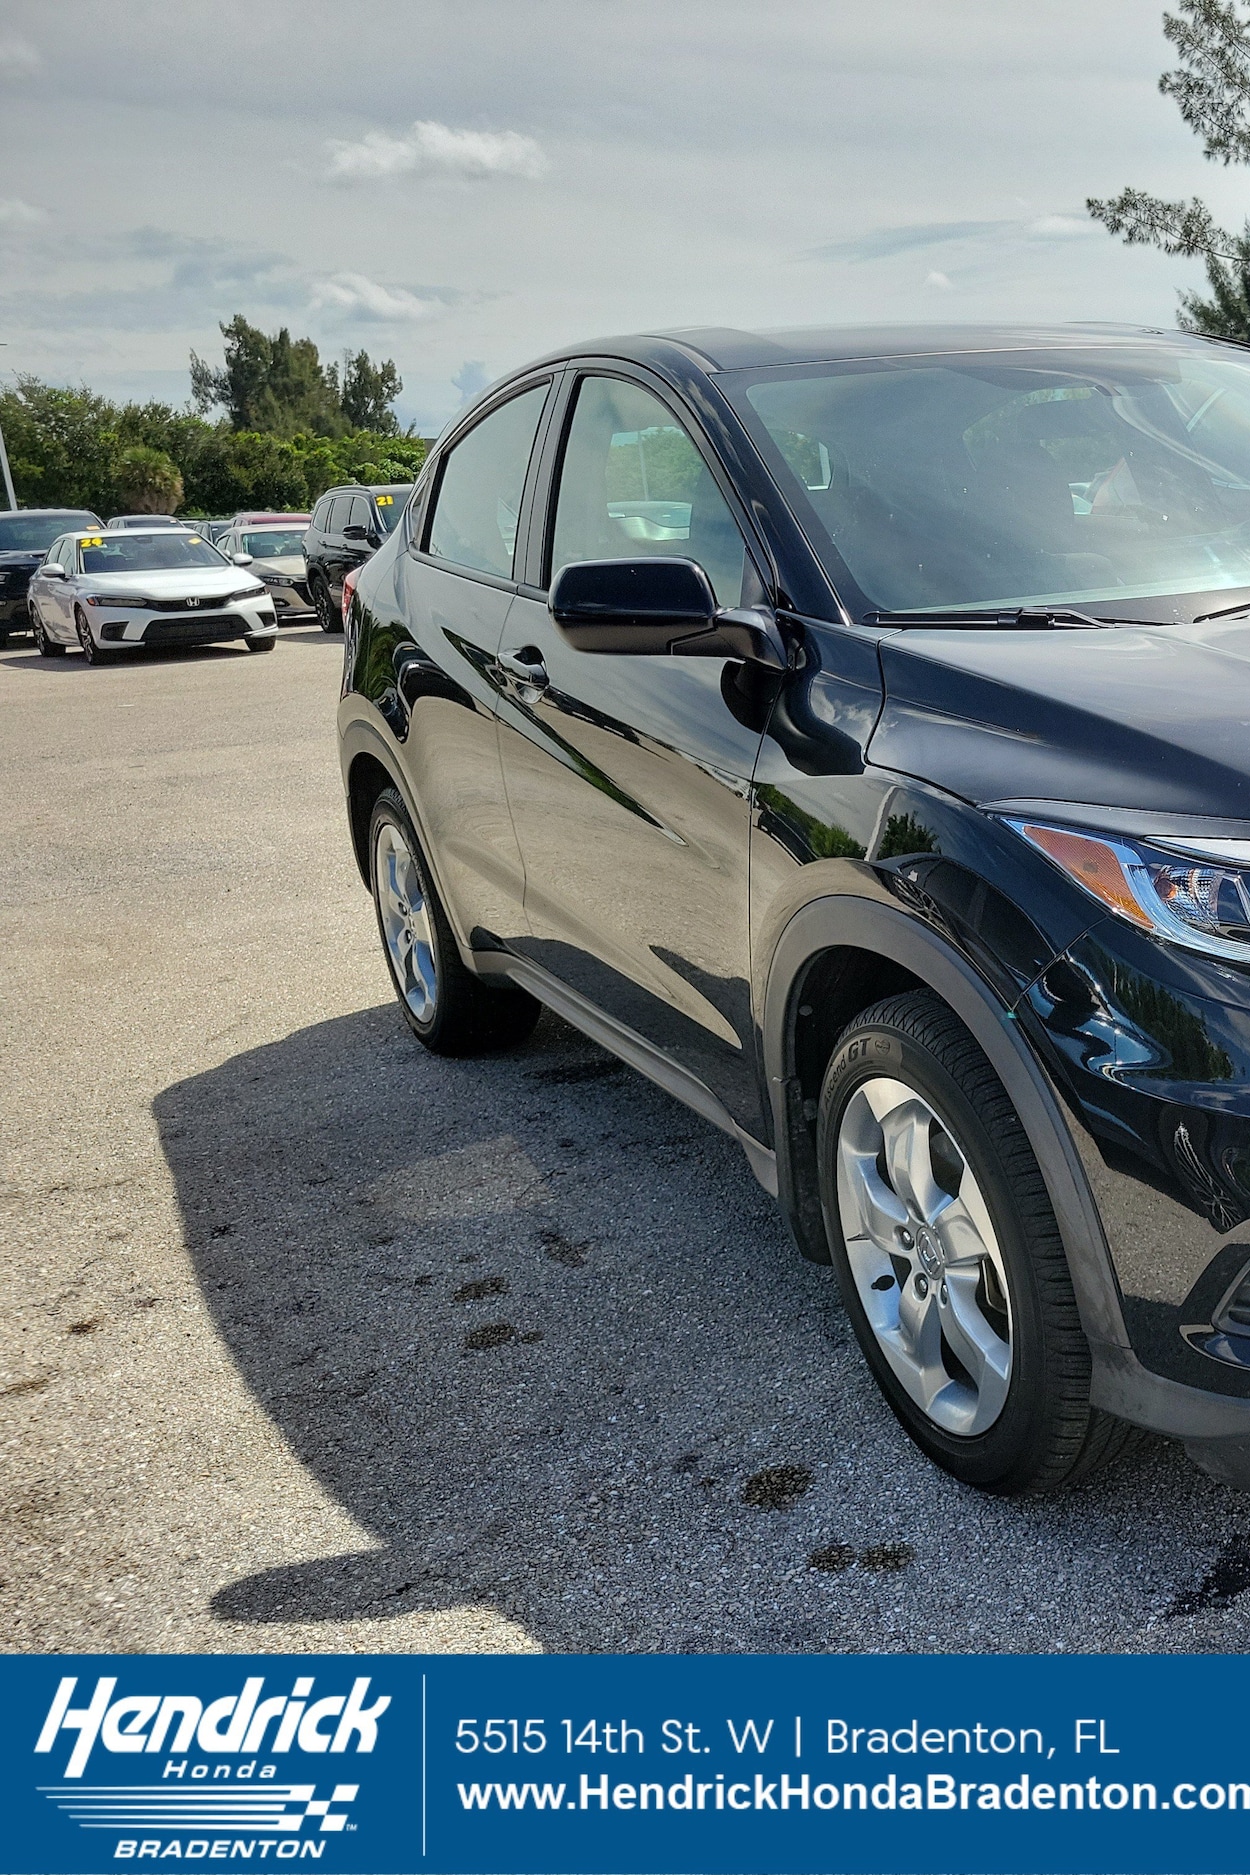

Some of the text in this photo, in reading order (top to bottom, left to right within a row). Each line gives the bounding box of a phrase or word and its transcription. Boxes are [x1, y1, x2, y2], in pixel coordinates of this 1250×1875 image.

[376, 495, 394, 506] 21
[80, 537, 103, 548] 24
[847, 1037, 872, 1062] GT
